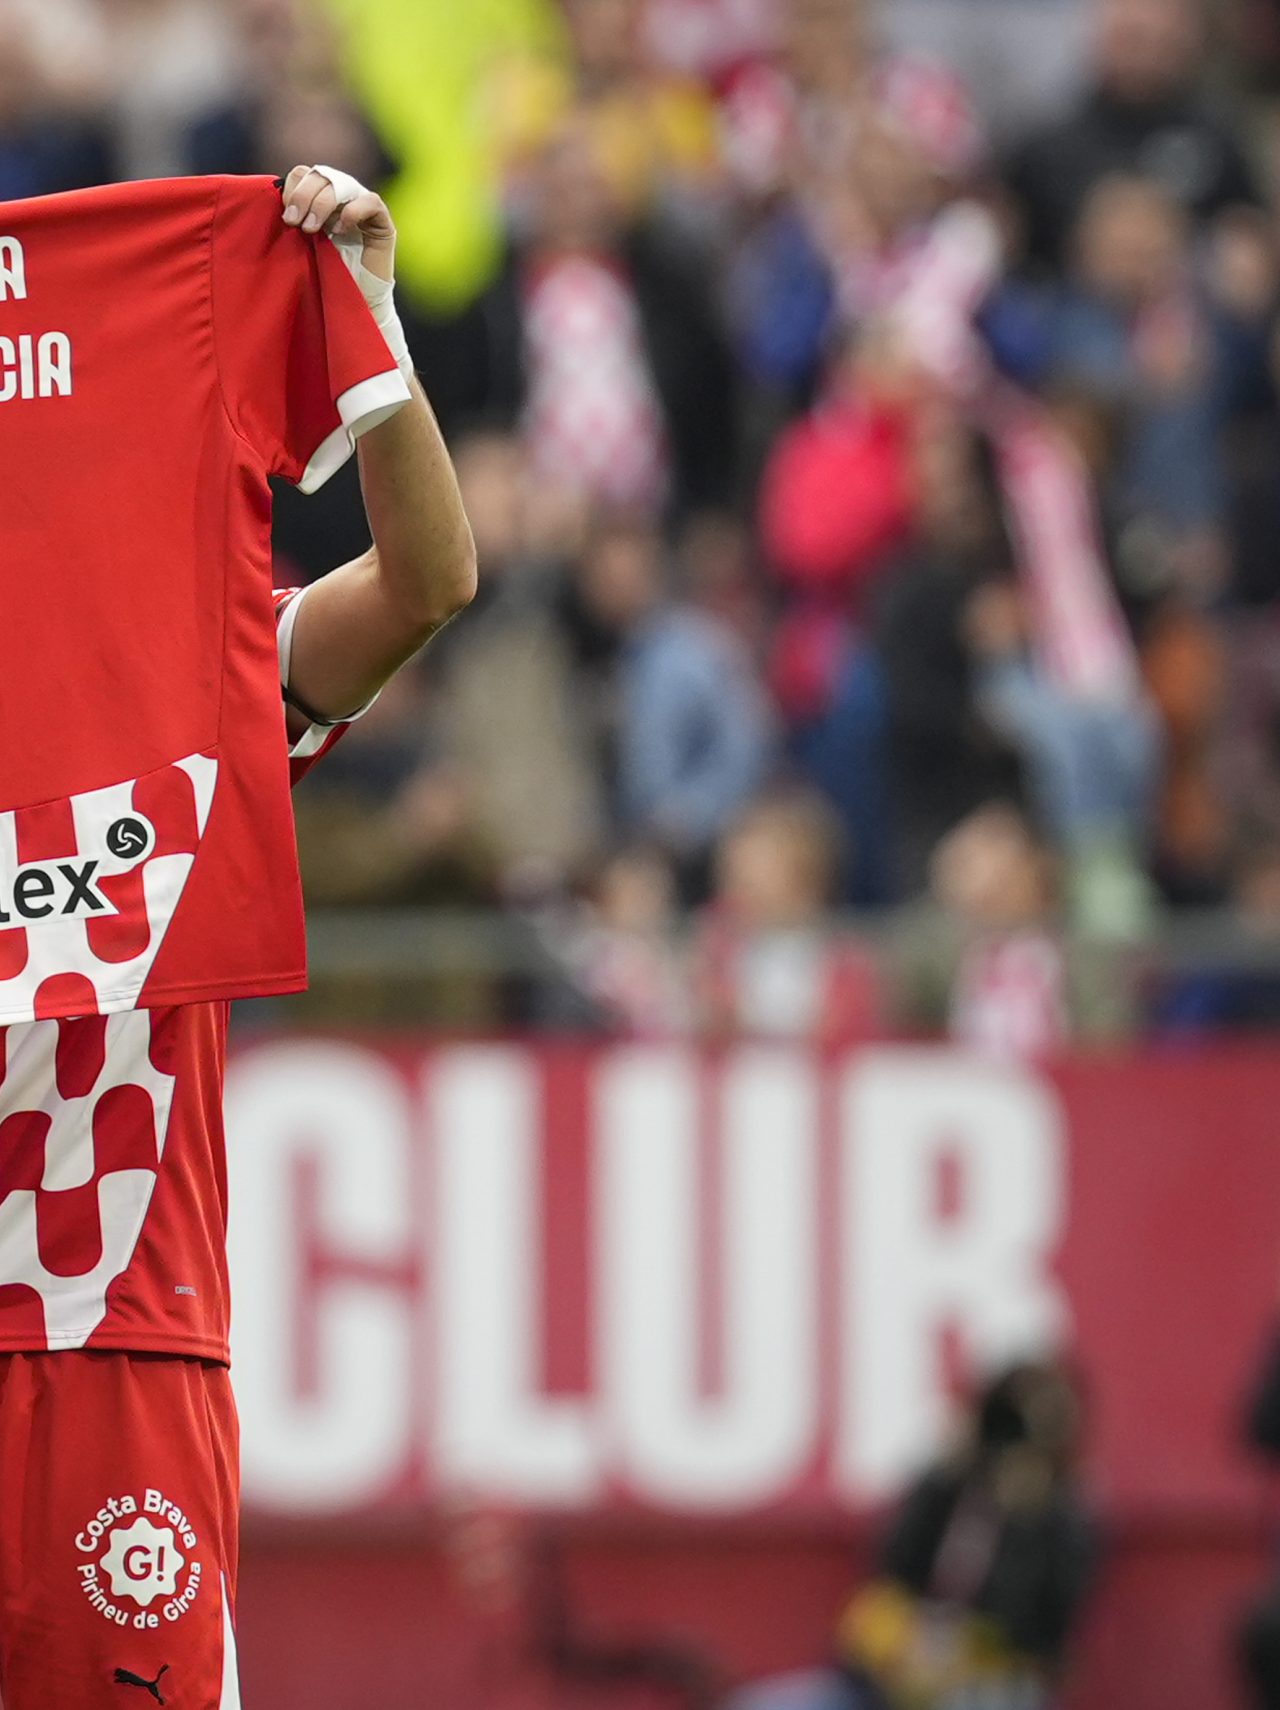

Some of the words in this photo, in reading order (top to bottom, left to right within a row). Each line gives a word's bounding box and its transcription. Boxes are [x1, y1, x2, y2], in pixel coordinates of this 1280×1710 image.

[220, 1038, 1070, 1514] CLUB
[74, 1494, 138, 1553] Costa
[142, 1487, 198, 1550] Brava
[76, 1562, 129, 1627] Pirineu
[132, 1610, 160, 1630] de
[162, 1560, 202, 1622] Girona
[122, 1544, 166, 1583] G!
